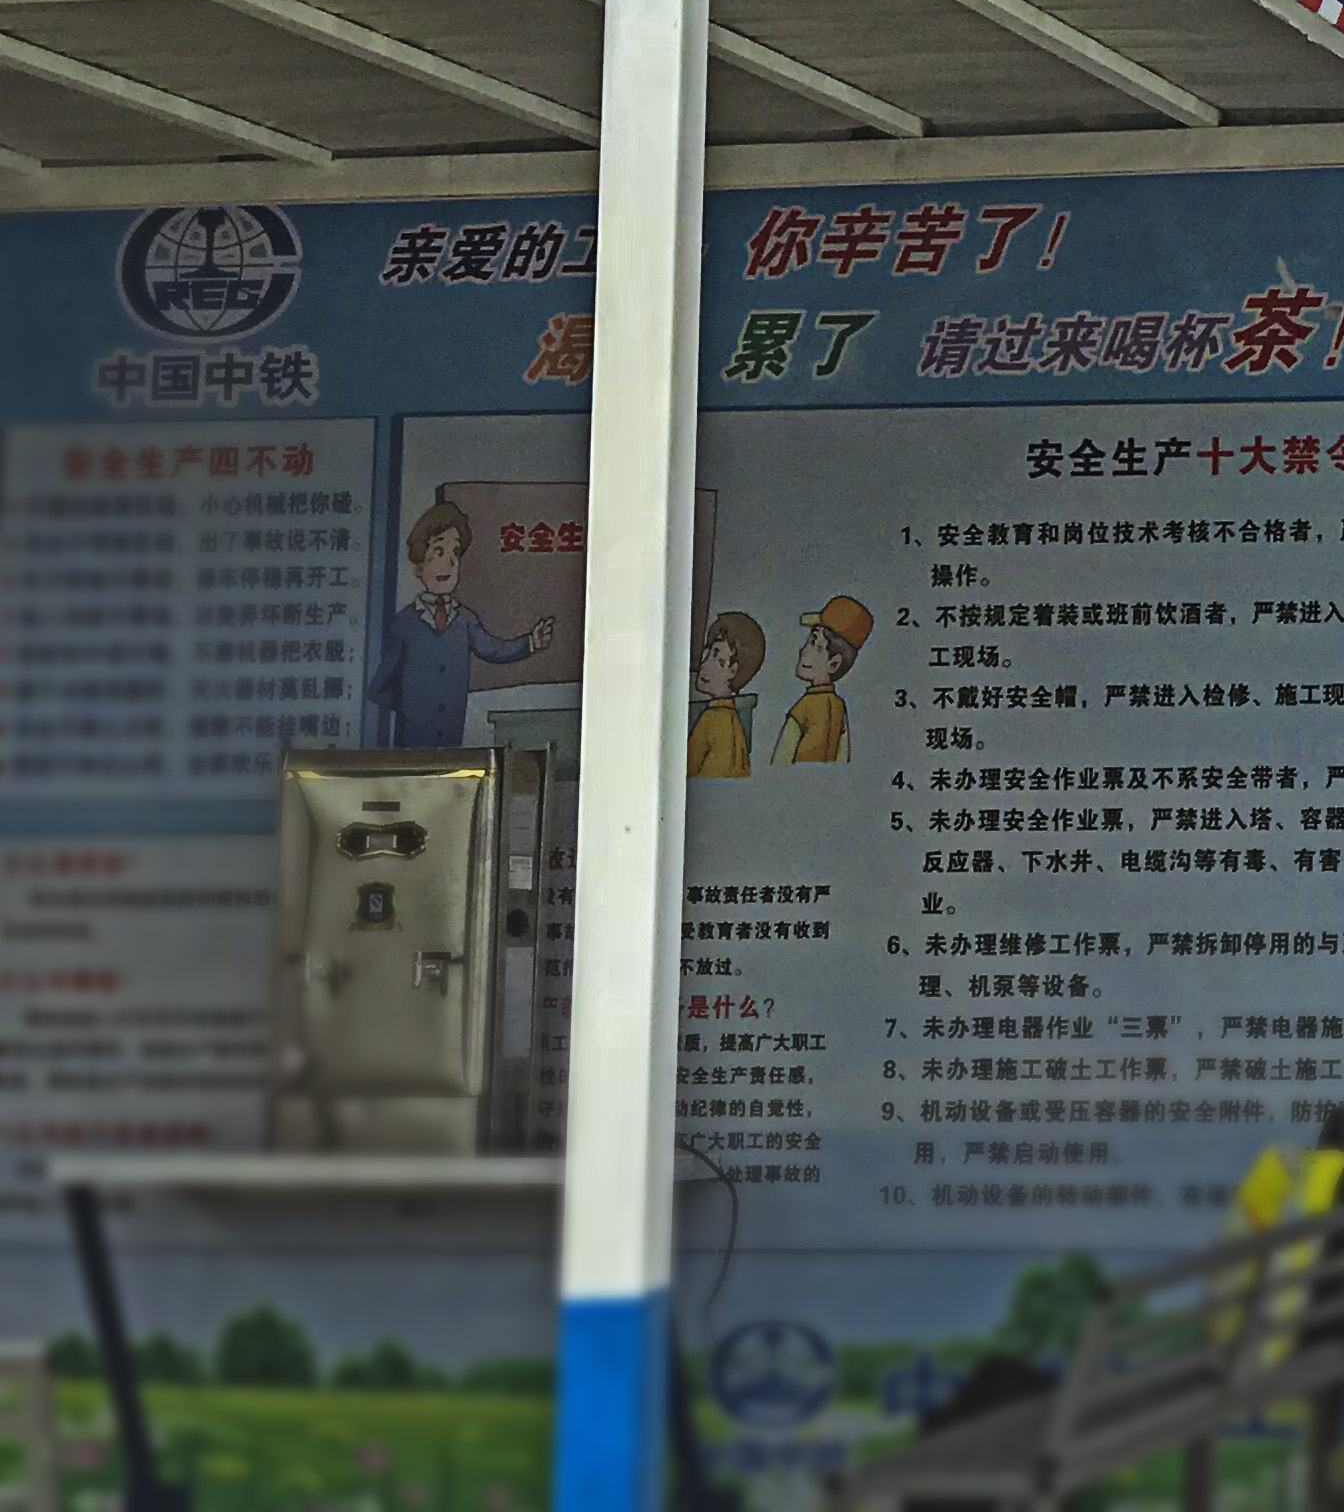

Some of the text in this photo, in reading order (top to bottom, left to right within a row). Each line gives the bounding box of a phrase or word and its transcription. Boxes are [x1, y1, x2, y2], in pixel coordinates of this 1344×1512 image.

[724, 310, 882, 385] 累了
[96, 350, 318, 402] 中国中铁
[930, 563, 990, 588] 操作。
[928, 644, 1012, 669] 工现场。
[925, 726, 985, 751] 现场。
[920, 891, 956, 916] 业。
[918, 973, 1103, 999] 理、机泵等设备。
